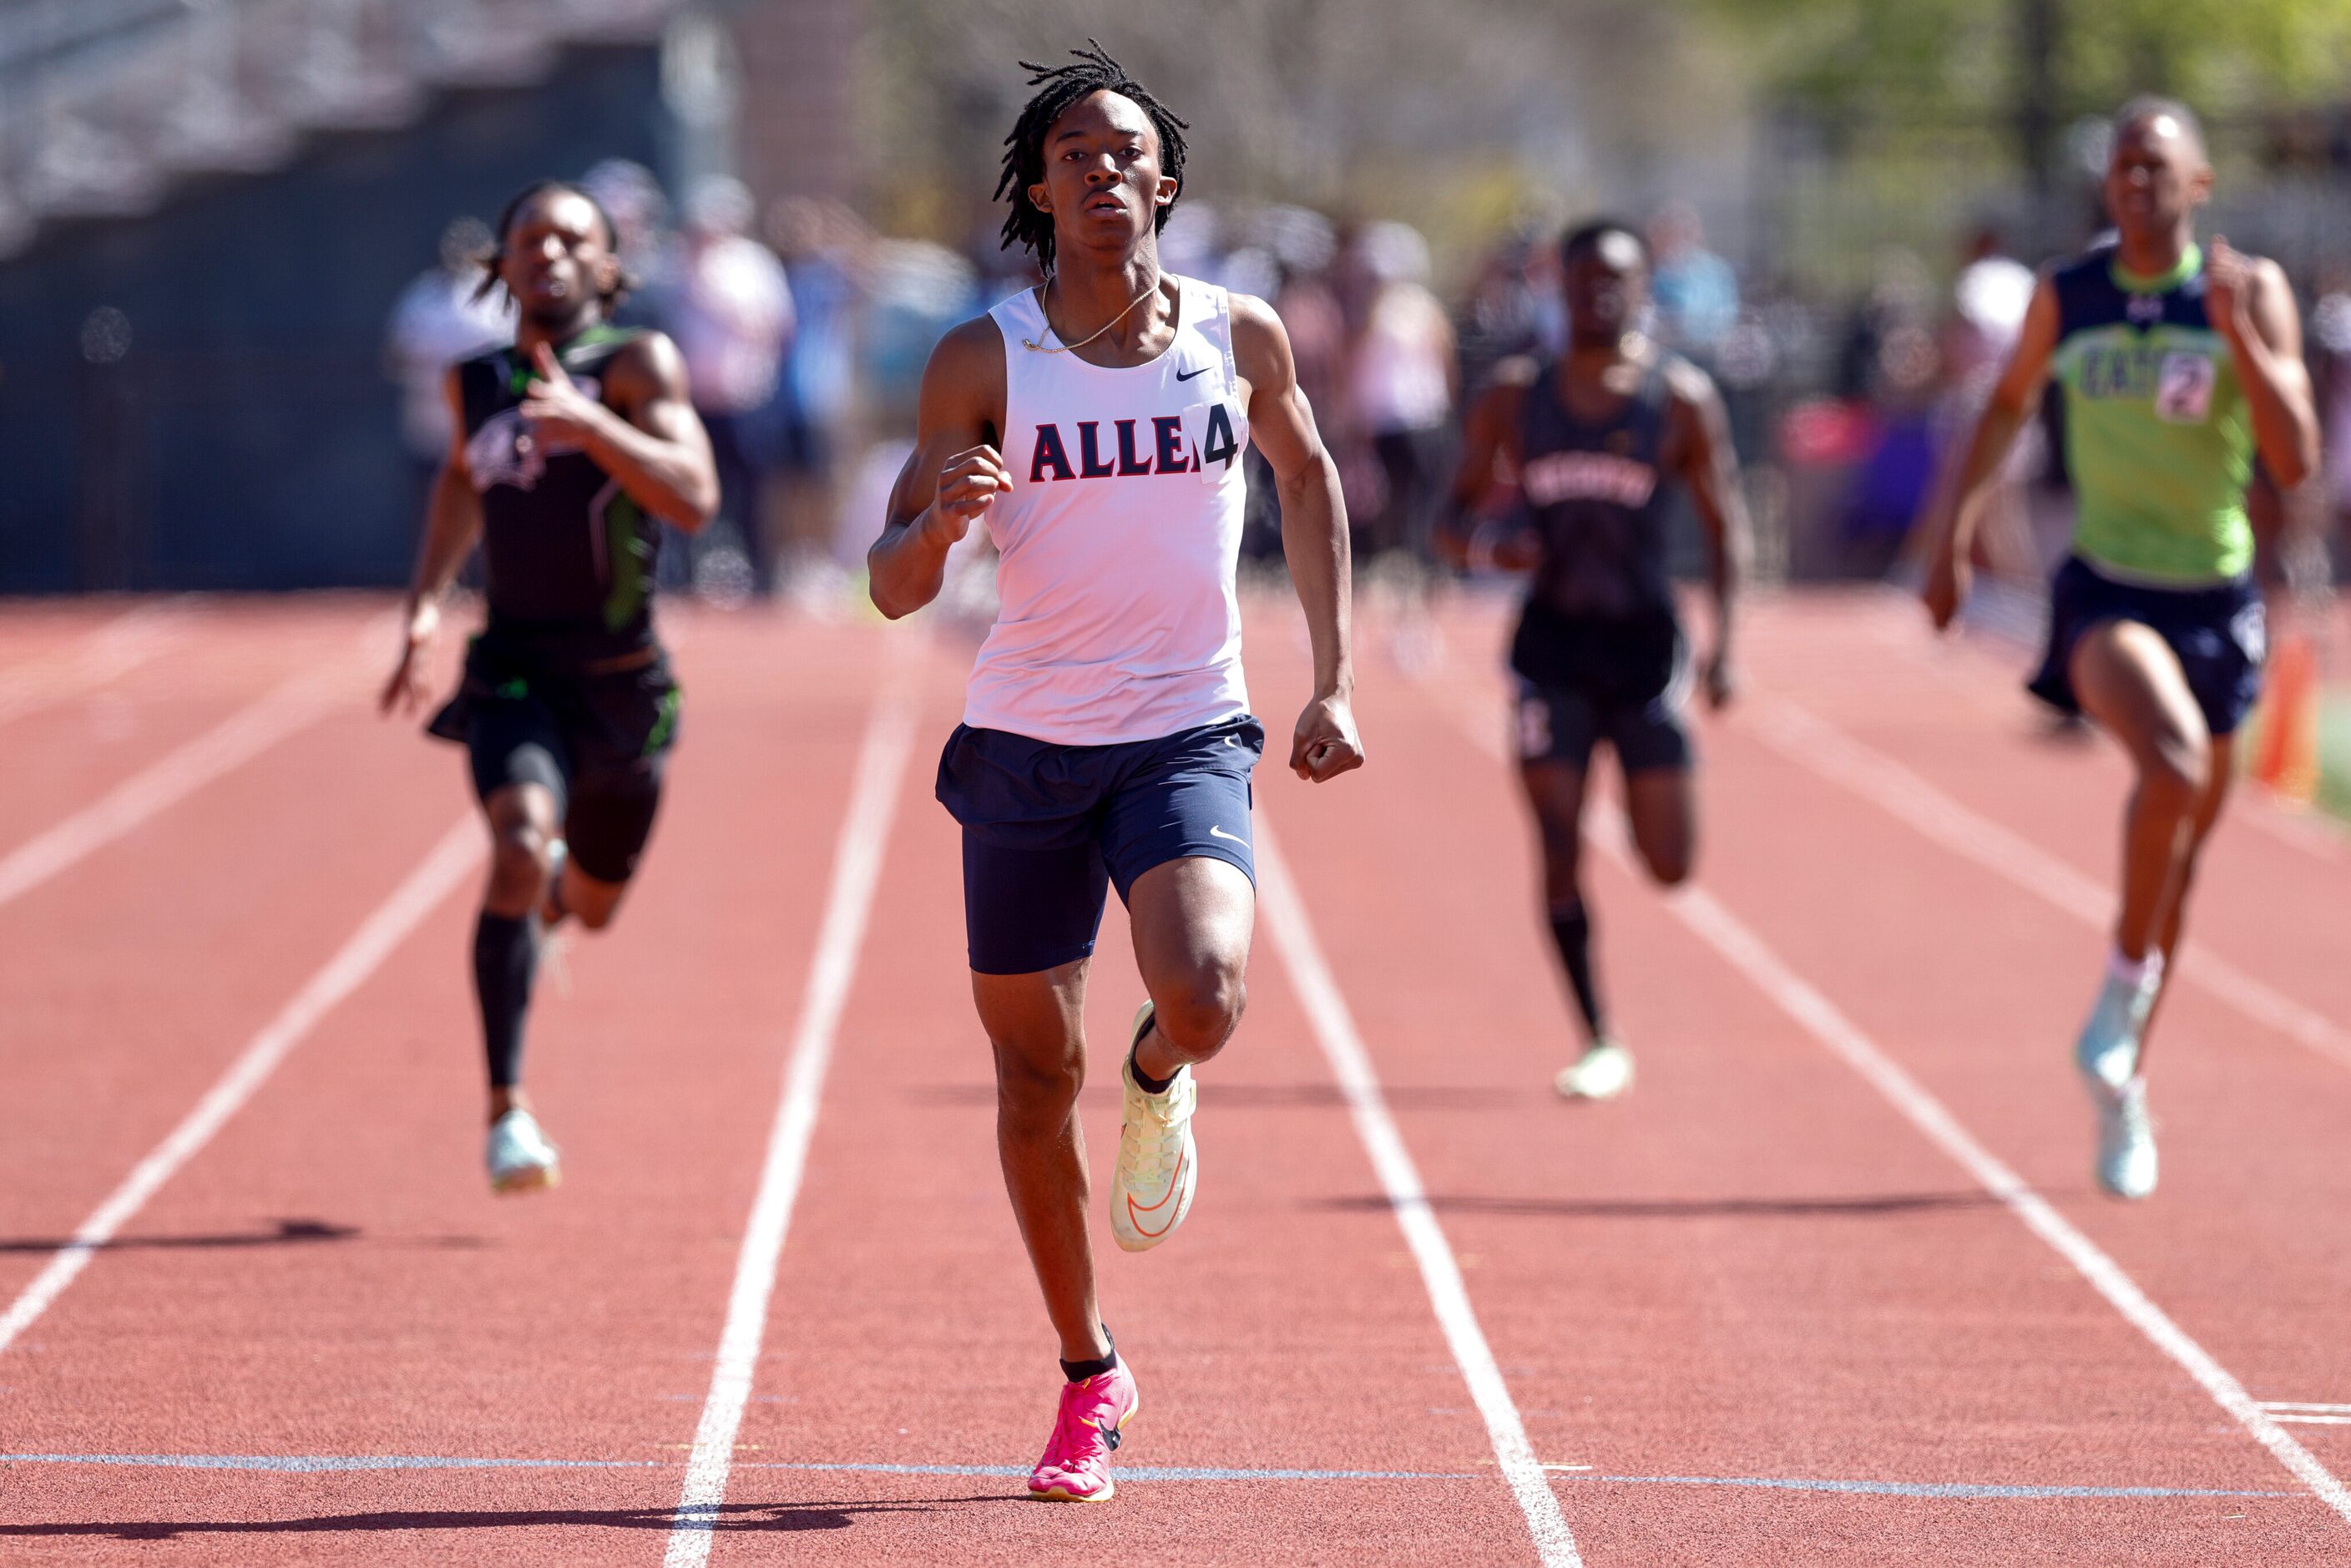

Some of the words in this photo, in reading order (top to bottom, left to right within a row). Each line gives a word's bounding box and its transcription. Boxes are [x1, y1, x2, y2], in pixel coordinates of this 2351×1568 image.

[2171, 356, 2202, 414] 2
[1029, 416, 1201, 483] ALLE
[1204, 403, 1238, 471] 4
